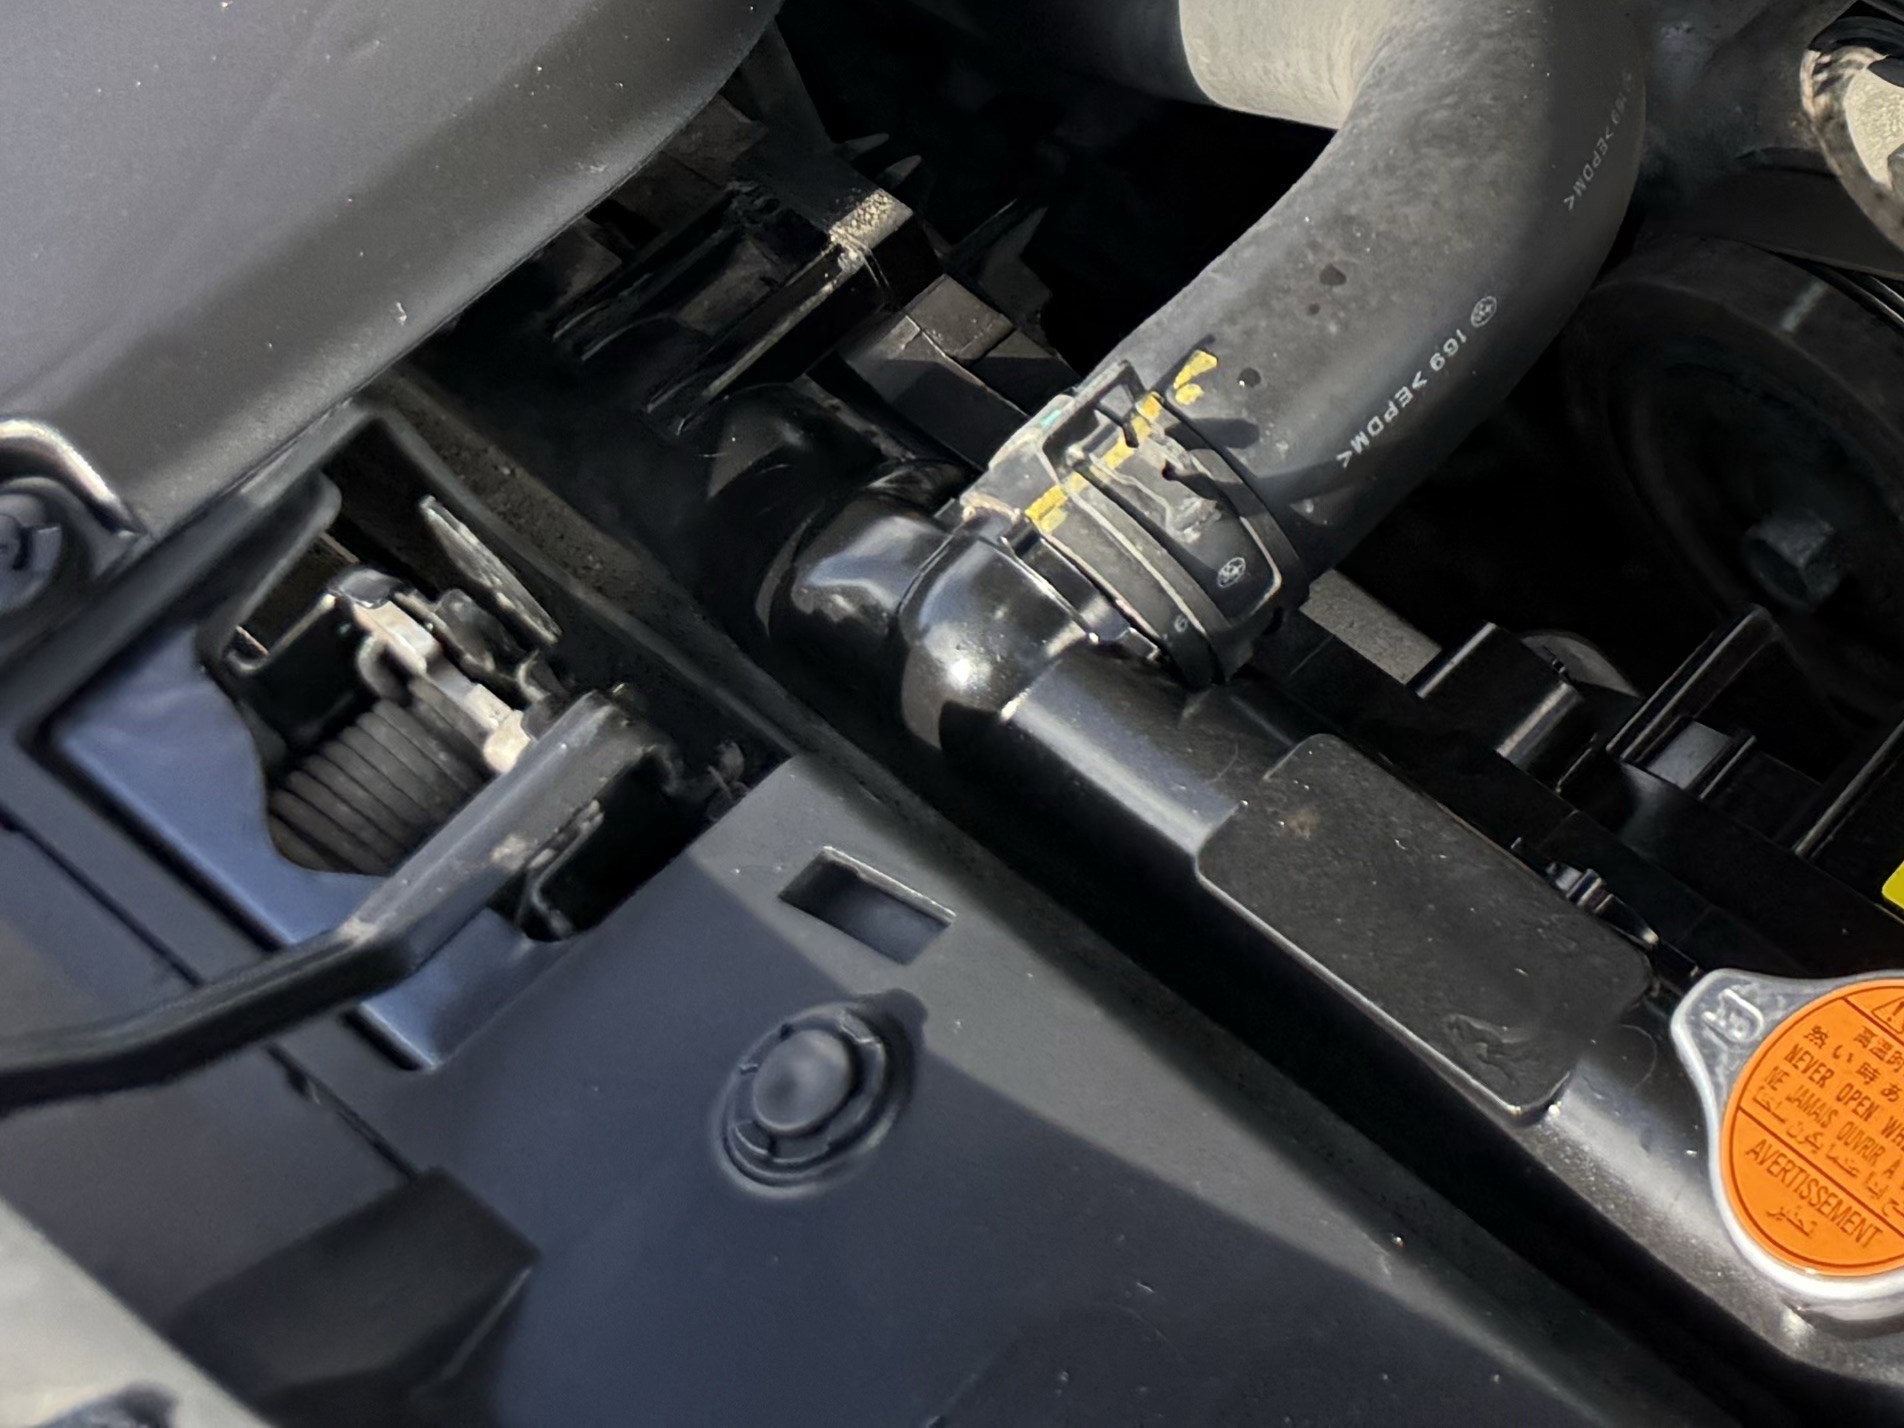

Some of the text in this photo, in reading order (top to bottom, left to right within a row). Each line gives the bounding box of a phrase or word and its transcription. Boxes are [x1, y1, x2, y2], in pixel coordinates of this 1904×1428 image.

[1783, 1041, 1836, 1091] NEVER
[1833, 1080, 1880, 1124] OPEN
[1784, 1080, 1840, 1131] JAMAIS
[1743, 1133, 1884, 1252] AVERTISSEMENT
